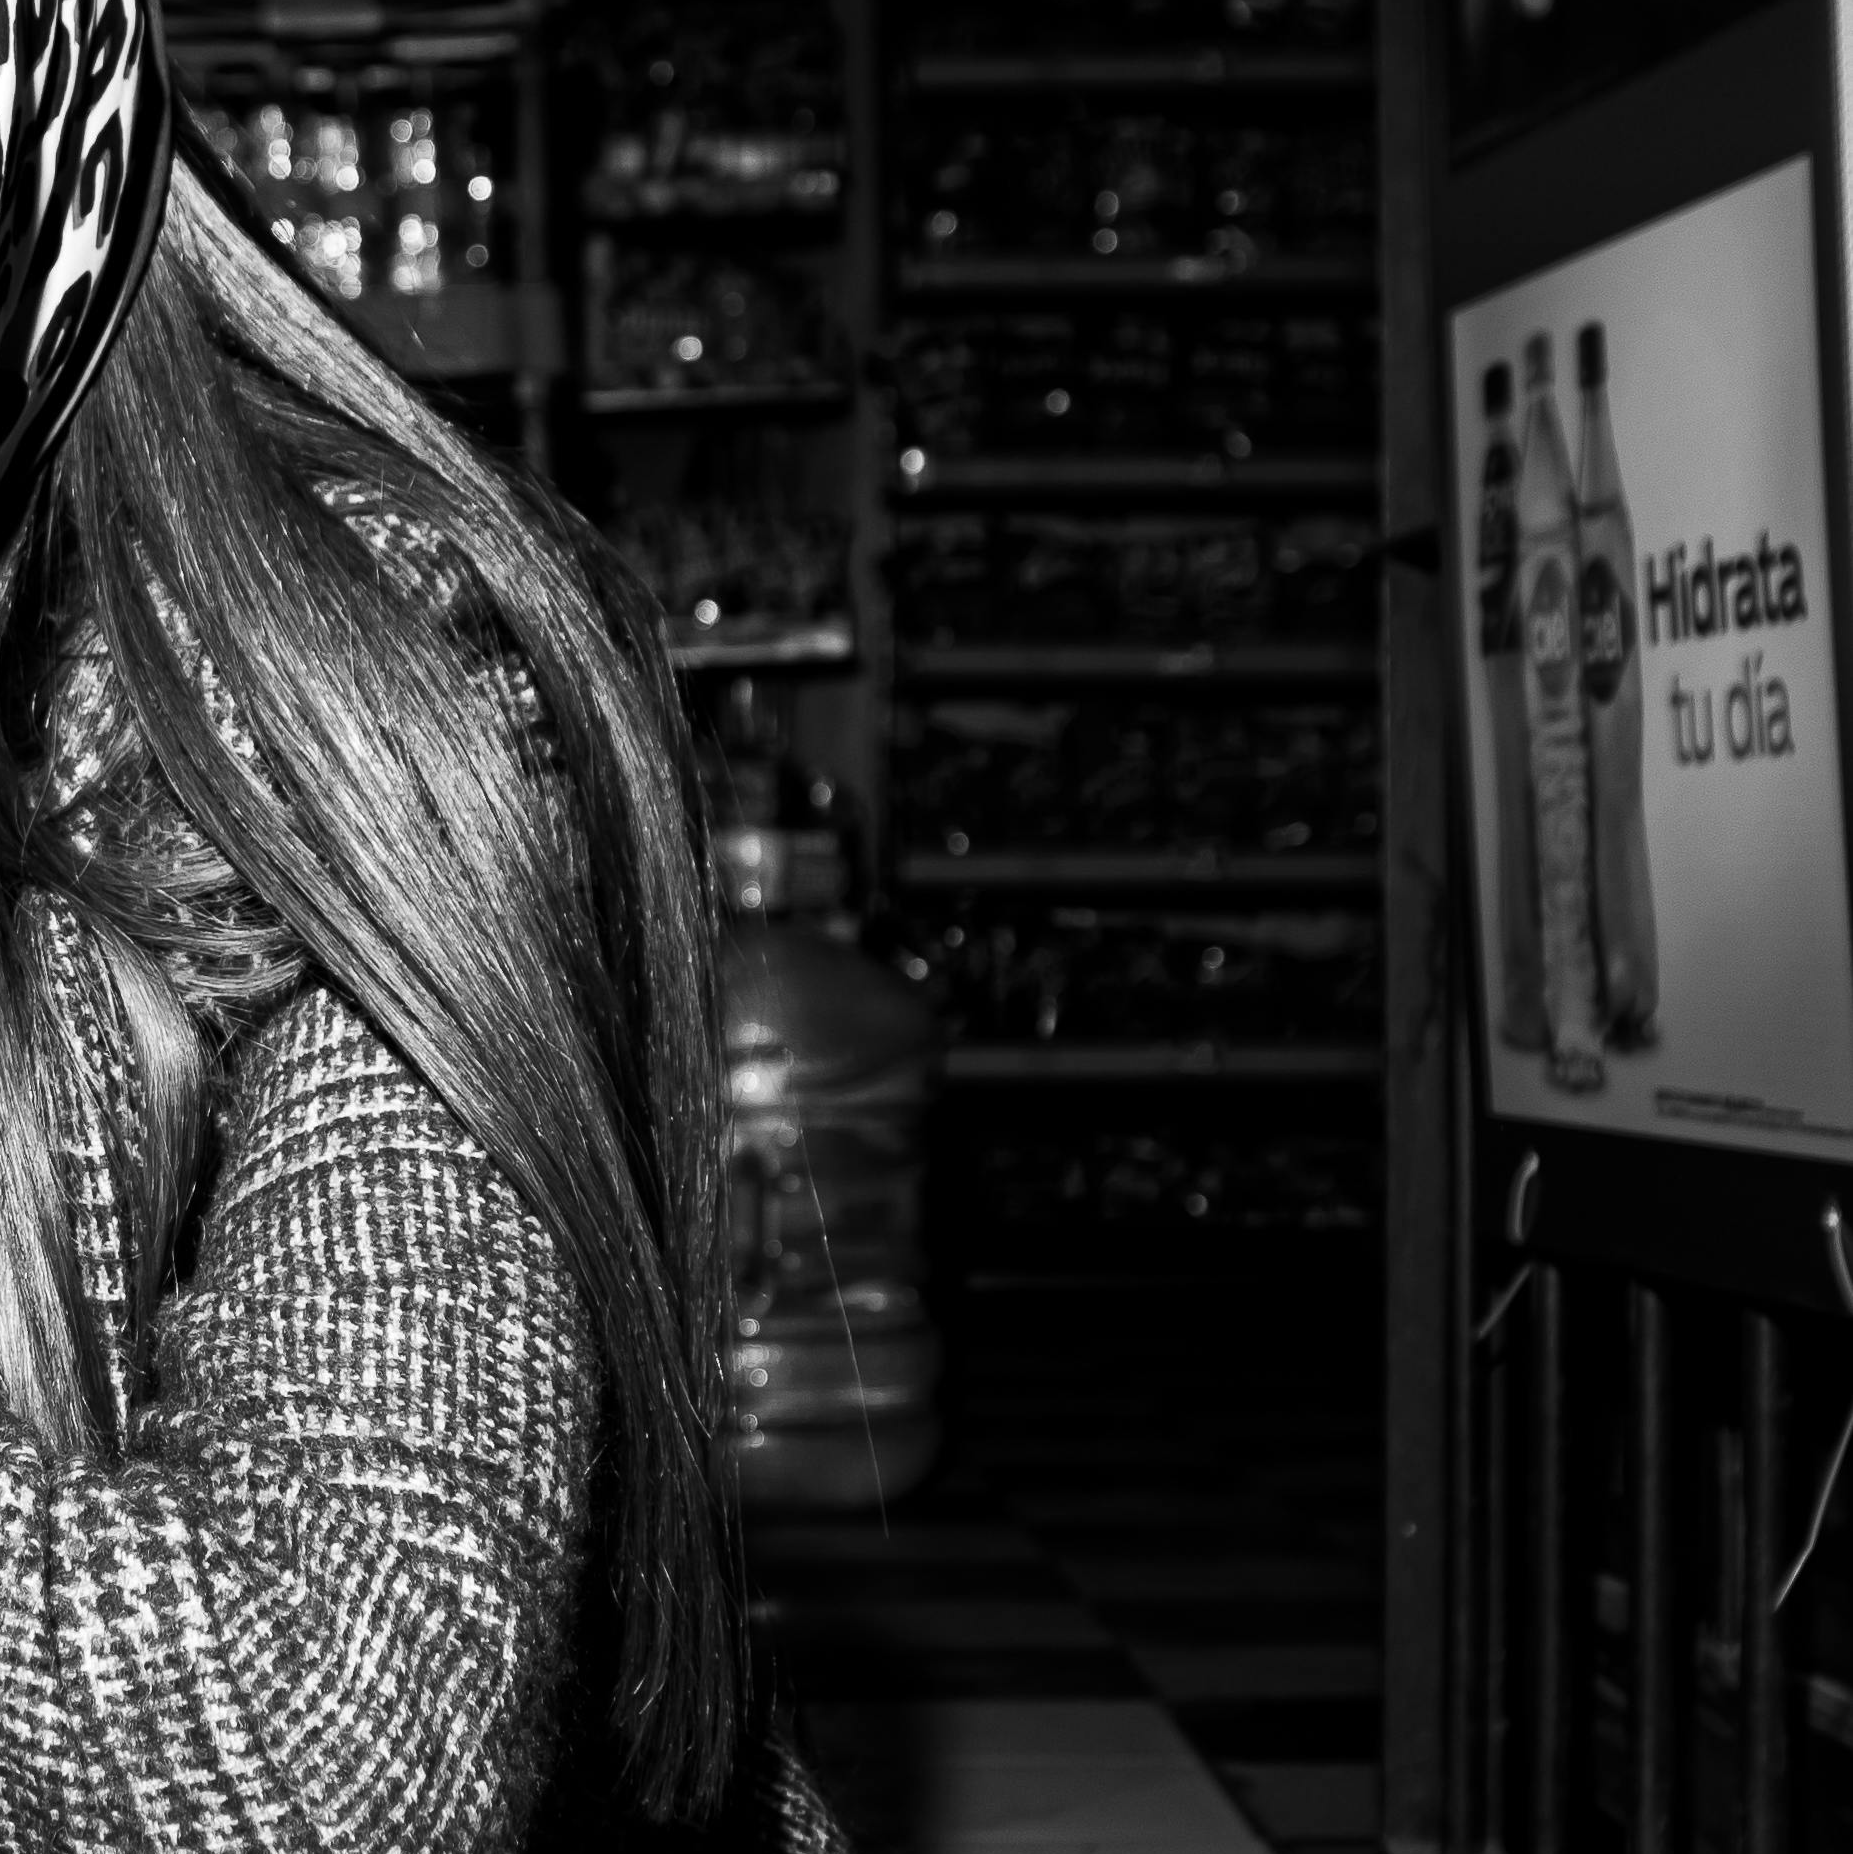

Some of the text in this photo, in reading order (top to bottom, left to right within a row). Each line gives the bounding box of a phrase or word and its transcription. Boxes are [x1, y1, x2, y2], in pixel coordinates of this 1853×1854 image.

[1644, 529, 1808, 646] Hidrata
[1668, 649, 1796, 767] tu día
